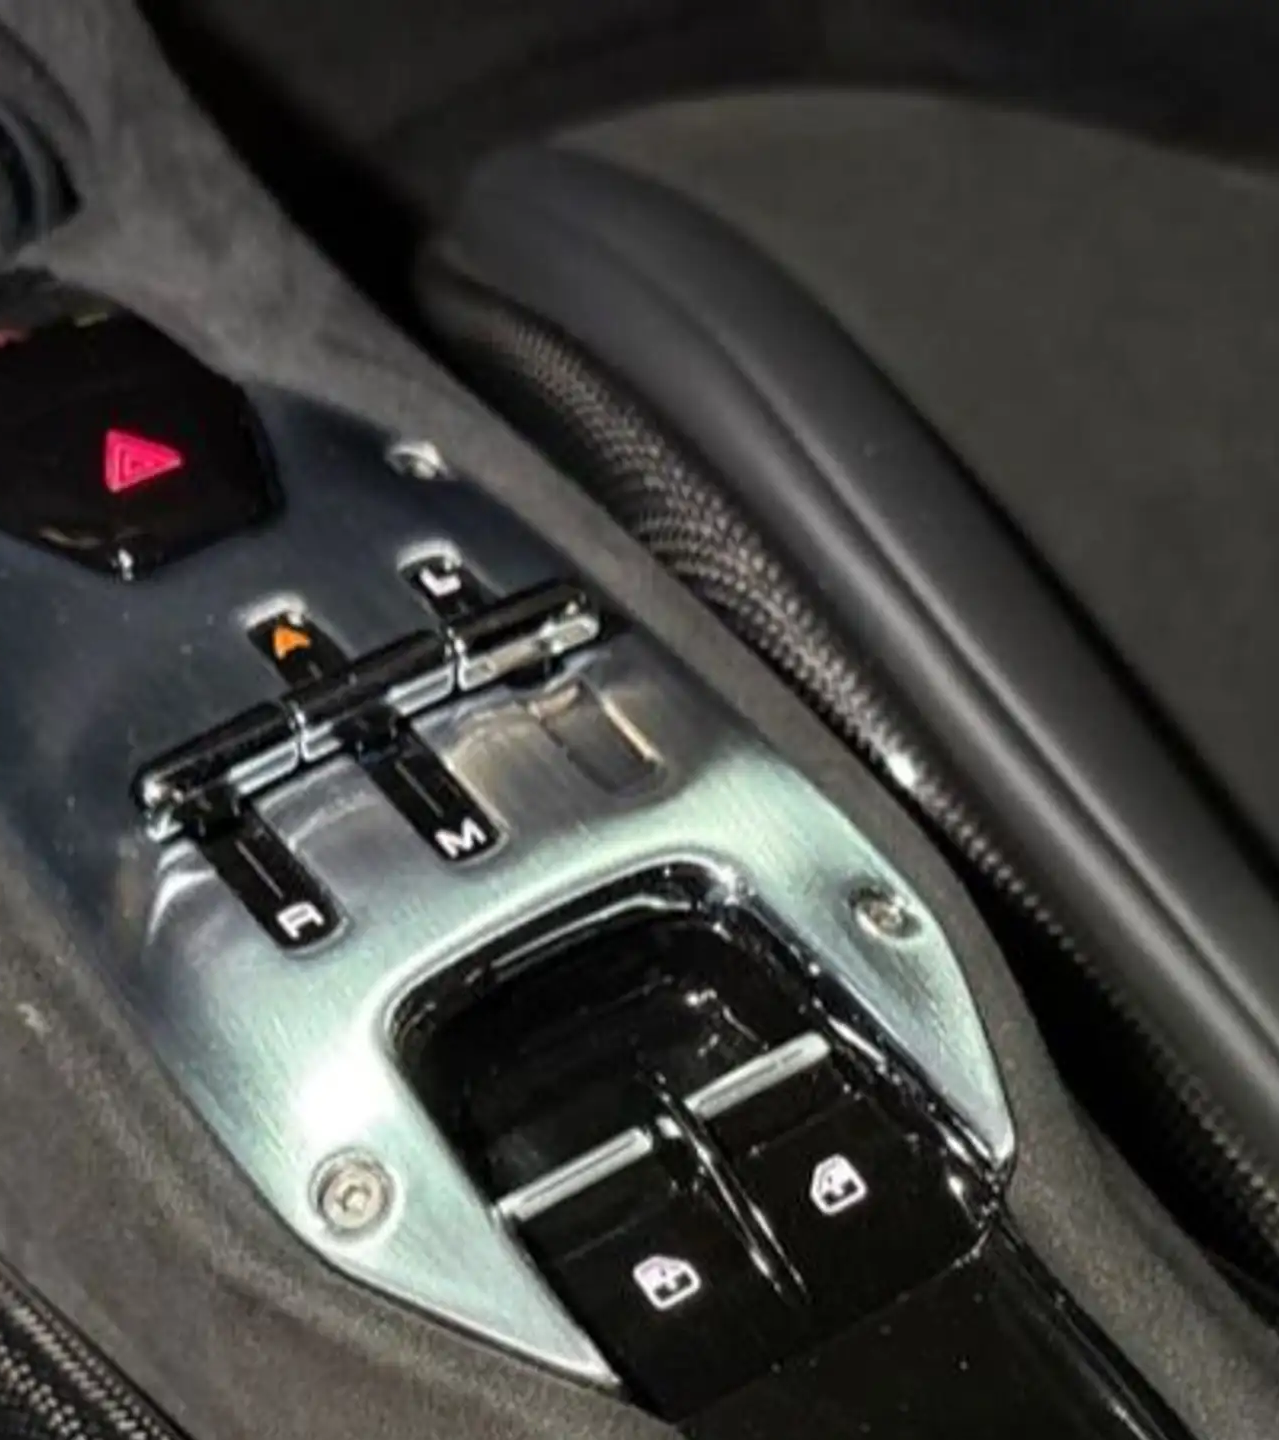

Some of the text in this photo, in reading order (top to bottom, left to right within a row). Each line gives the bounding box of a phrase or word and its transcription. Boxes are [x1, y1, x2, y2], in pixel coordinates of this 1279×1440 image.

[273, 625, 311, 660] A
[434, 817, 487, 859] M
[277, 901, 324, 939] R
